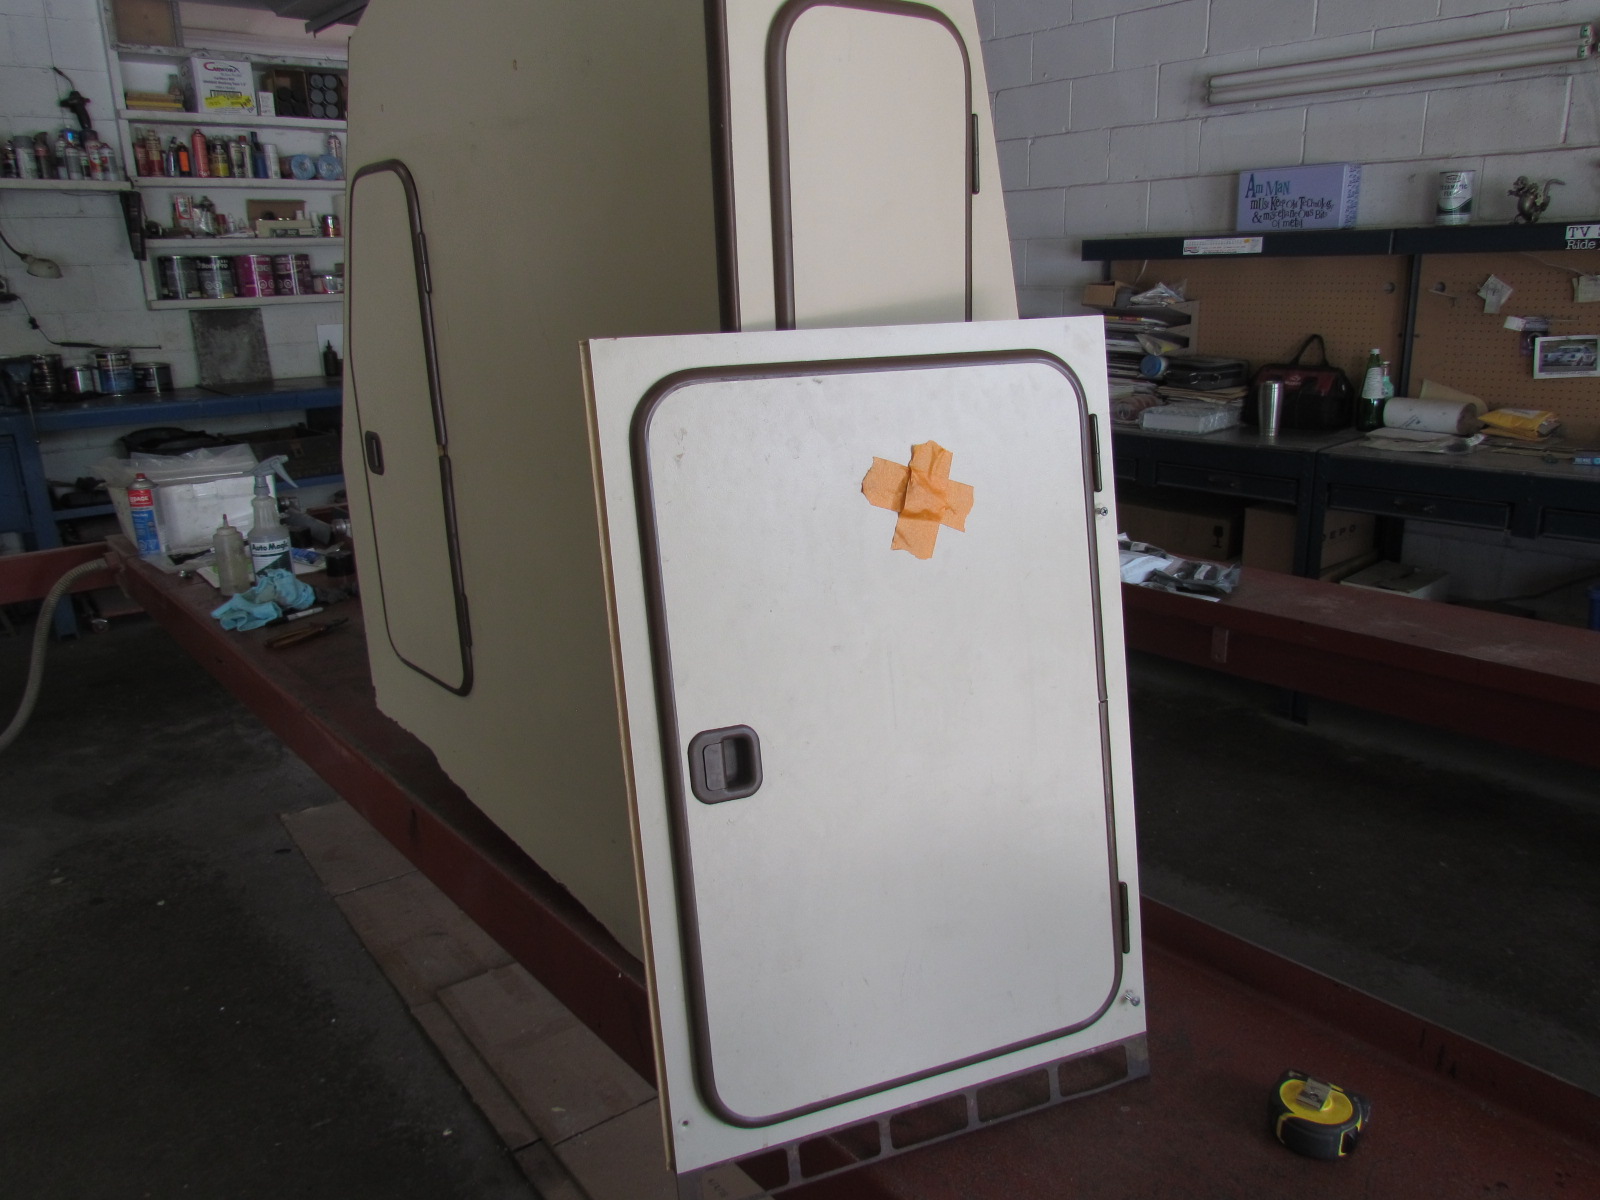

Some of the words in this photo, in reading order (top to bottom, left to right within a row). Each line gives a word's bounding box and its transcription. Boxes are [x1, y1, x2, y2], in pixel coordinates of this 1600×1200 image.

[1252, 210, 1263, 223] &
[1568, 226, 1590, 238] TV
[1565, 239, 1596, 250] Ride
[251, 543, 268, 552] Auto
